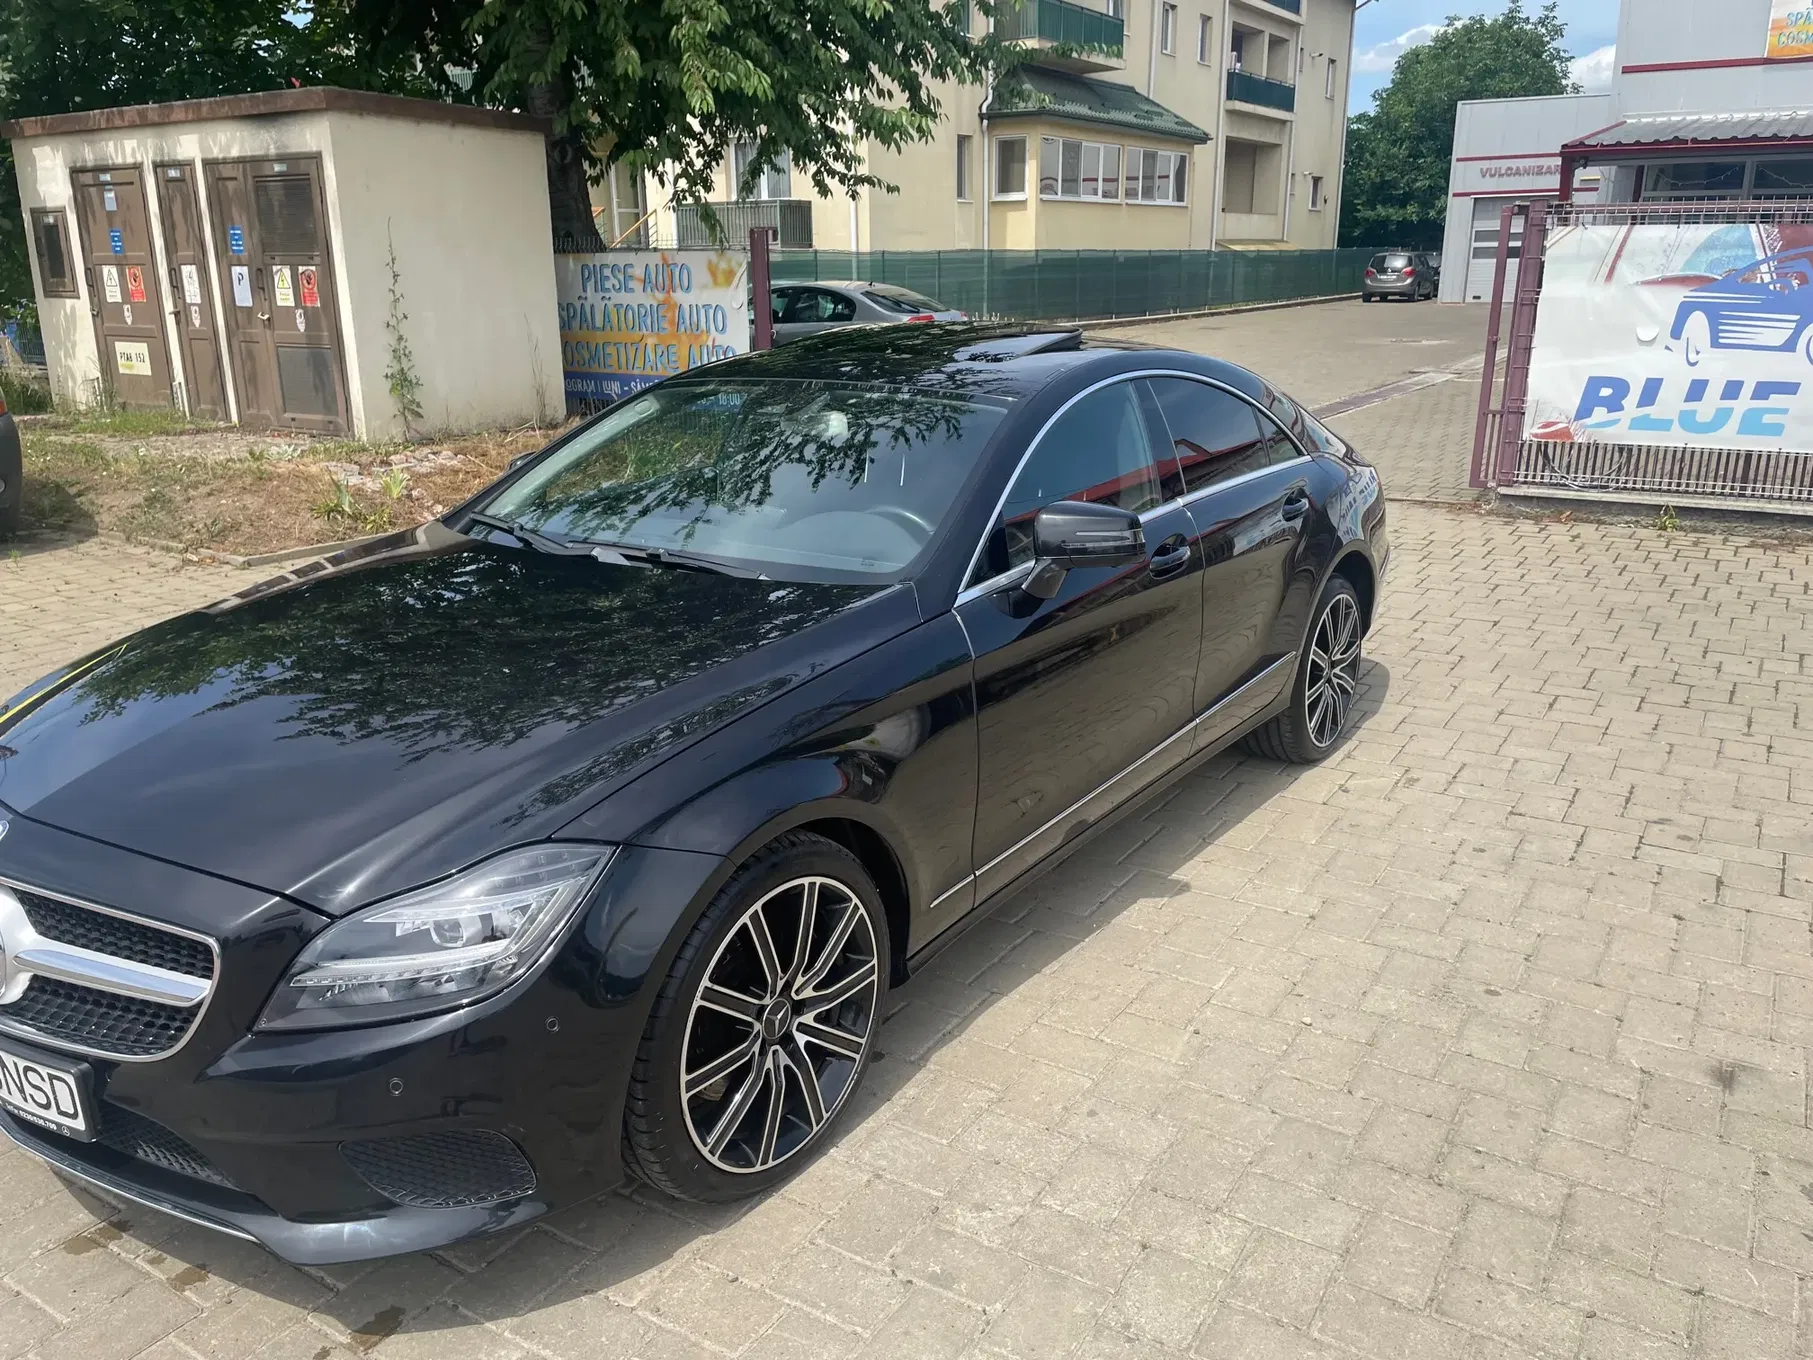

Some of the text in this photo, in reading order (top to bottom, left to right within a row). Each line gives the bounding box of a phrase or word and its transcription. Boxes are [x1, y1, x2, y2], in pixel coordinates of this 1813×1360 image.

[1480, 164, 1561, 179] VULCANIZAR
[581, 262, 693, 294] PIESE AUTO
[676, 303, 728, 336] AUTO
[563, 341, 681, 373] OSMETIZARE
[565, 378, 596, 392] OGRAM
[602, 380, 621, 398] LUNI
[1573, 376, 1802, 437] BLUE
